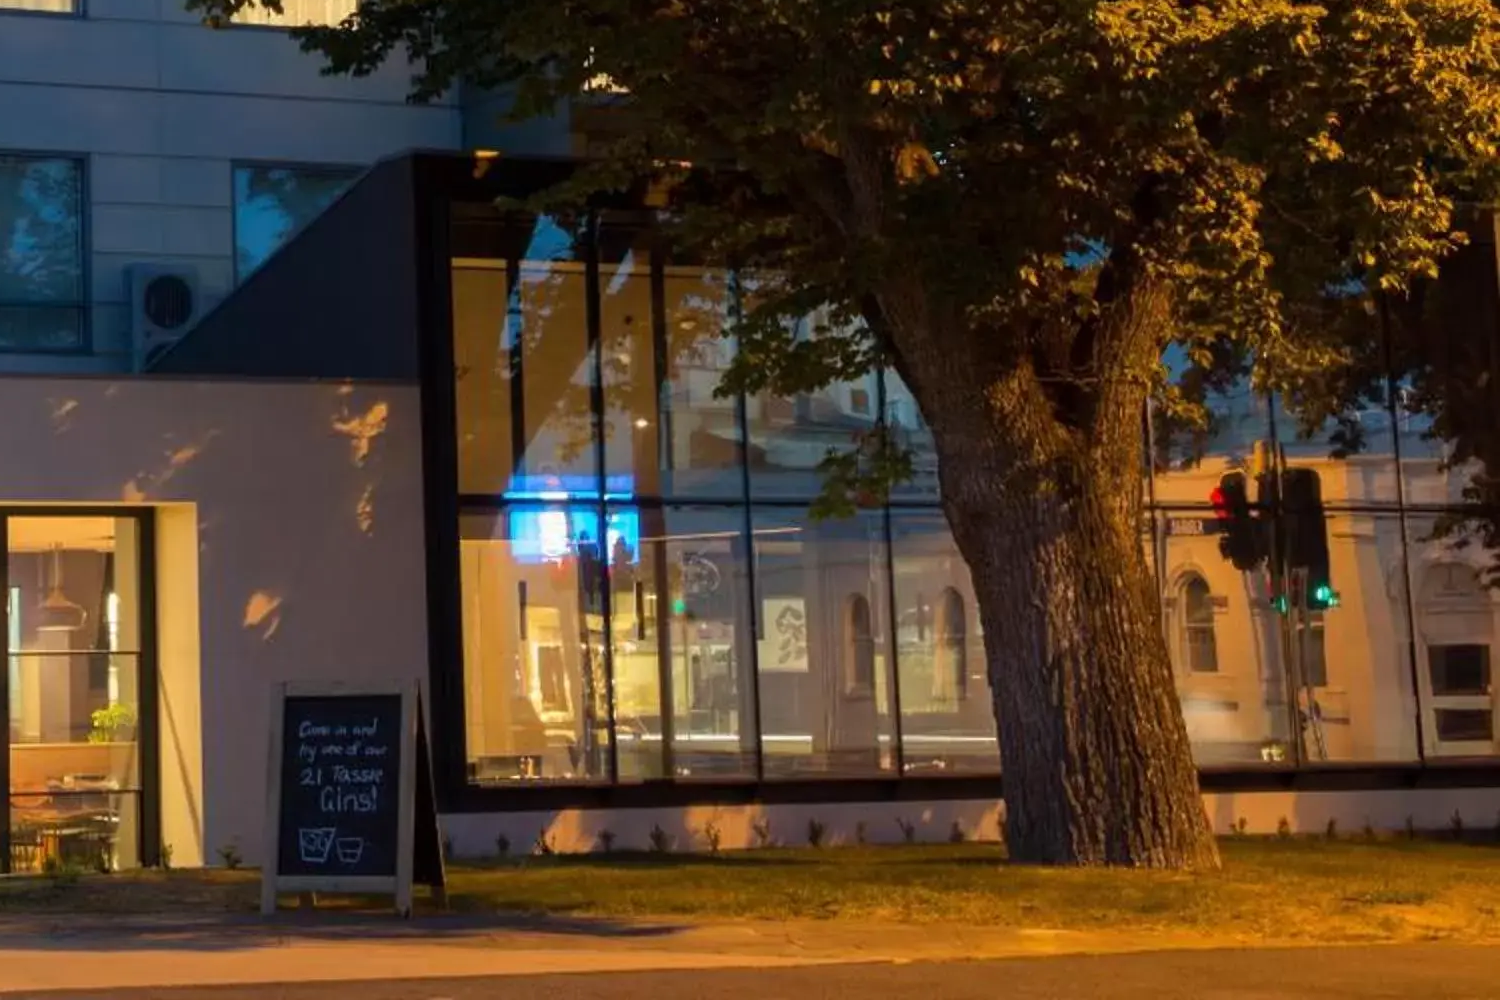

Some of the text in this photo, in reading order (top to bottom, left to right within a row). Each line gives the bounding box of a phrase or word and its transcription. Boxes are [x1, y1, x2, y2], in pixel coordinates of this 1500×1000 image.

[352, 717, 378, 736] and
[300, 767, 322, 785] 21
[321, 785, 377, 812] Gins!
